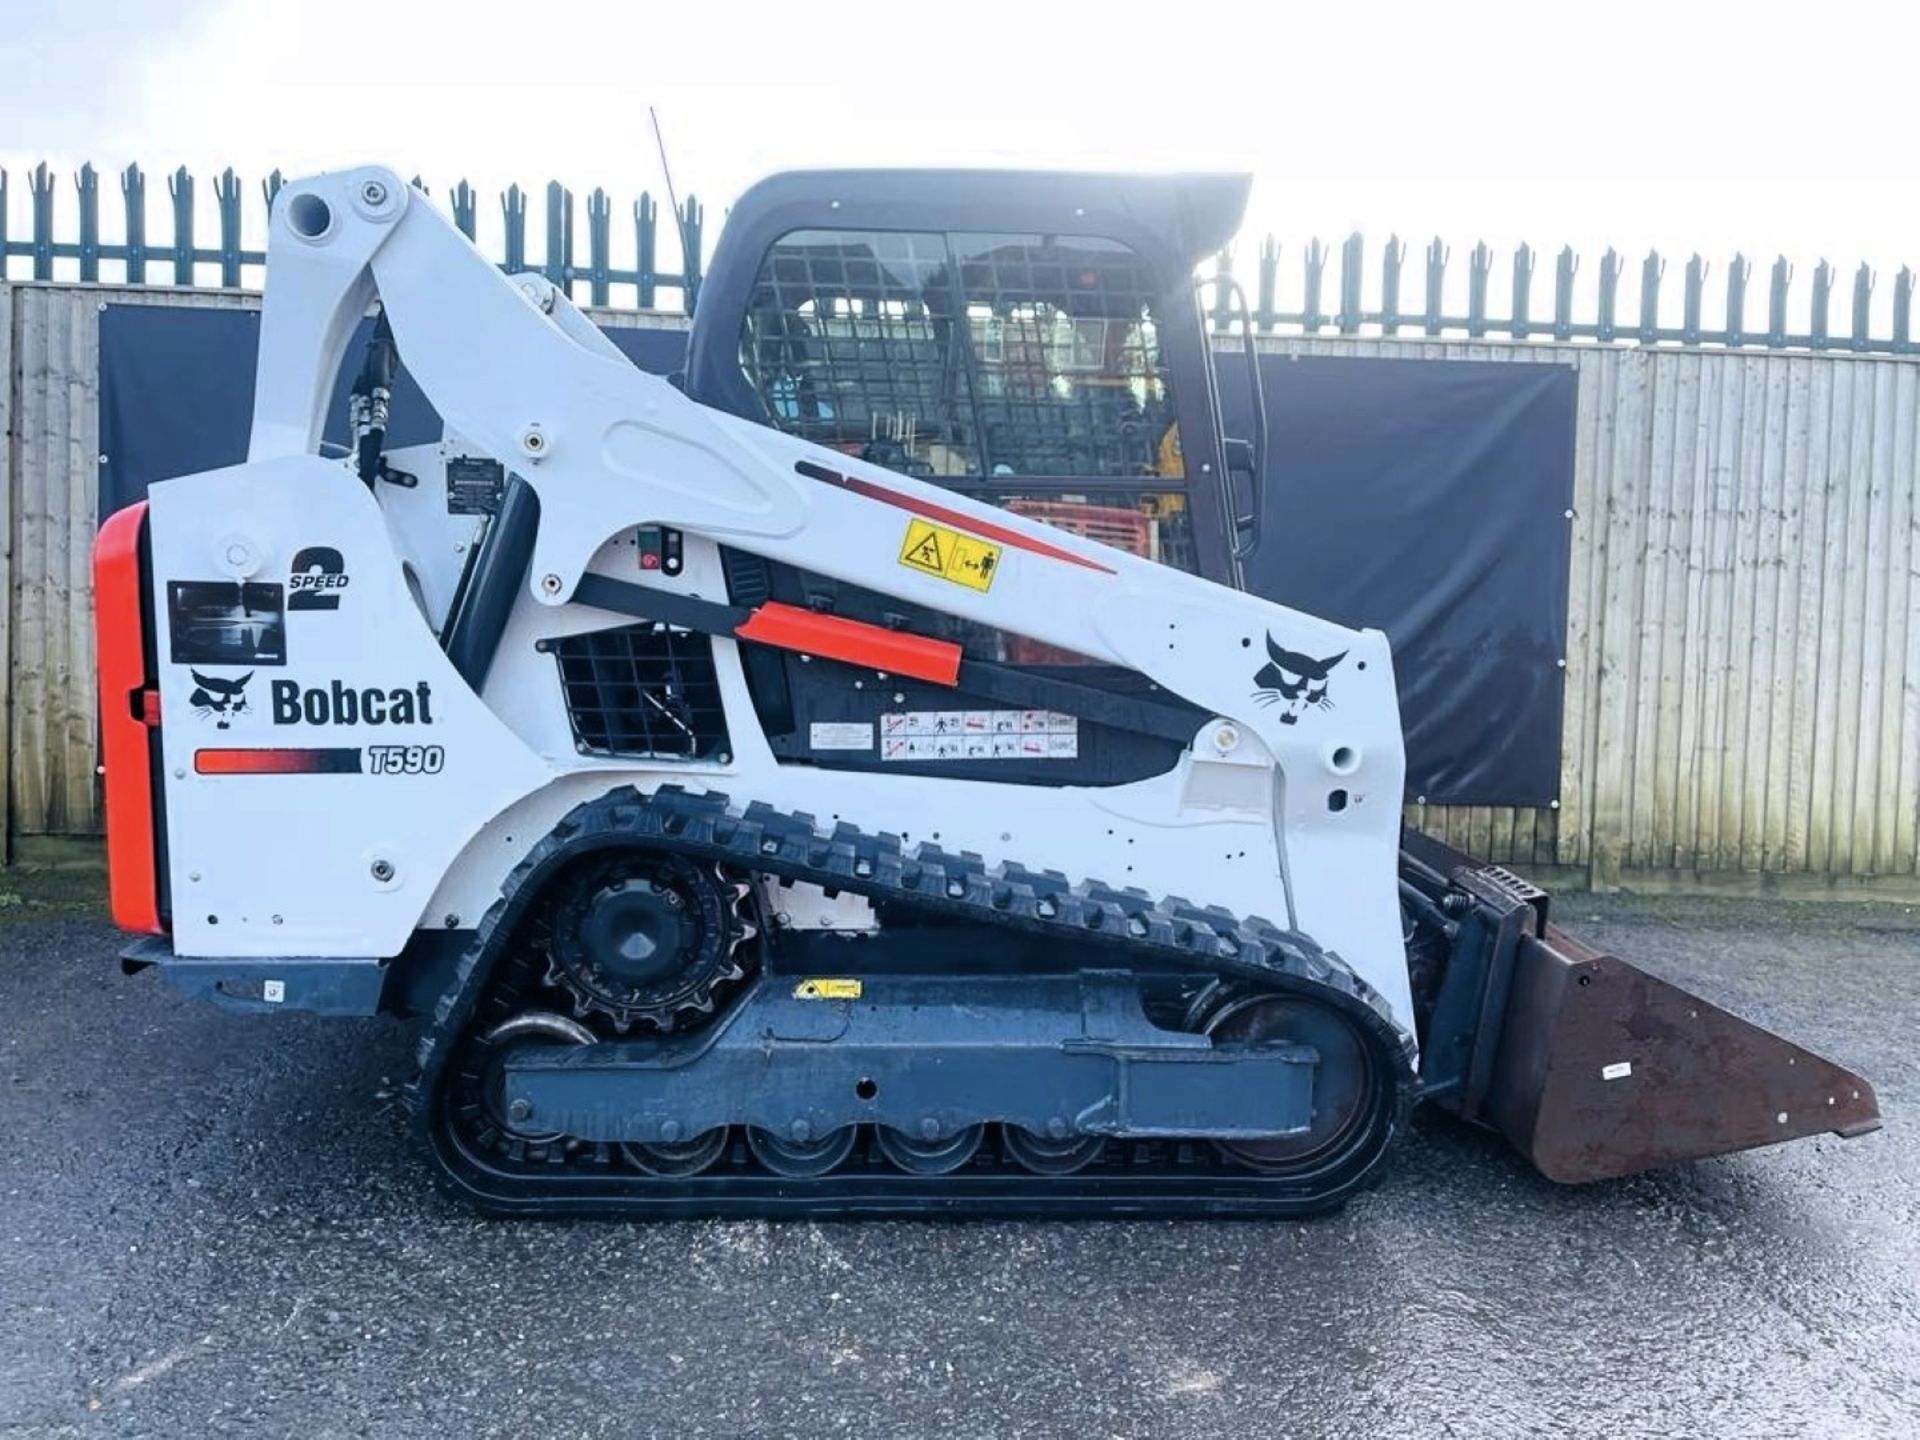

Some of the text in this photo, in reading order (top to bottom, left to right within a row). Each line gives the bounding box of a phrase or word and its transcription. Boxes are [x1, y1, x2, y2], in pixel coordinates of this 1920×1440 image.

[288, 546, 344, 611] 2
[290, 575, 349, 588] SPEED
[271, 679, 433, 726] Bobcat
[368, 745, 445, 774] T590
